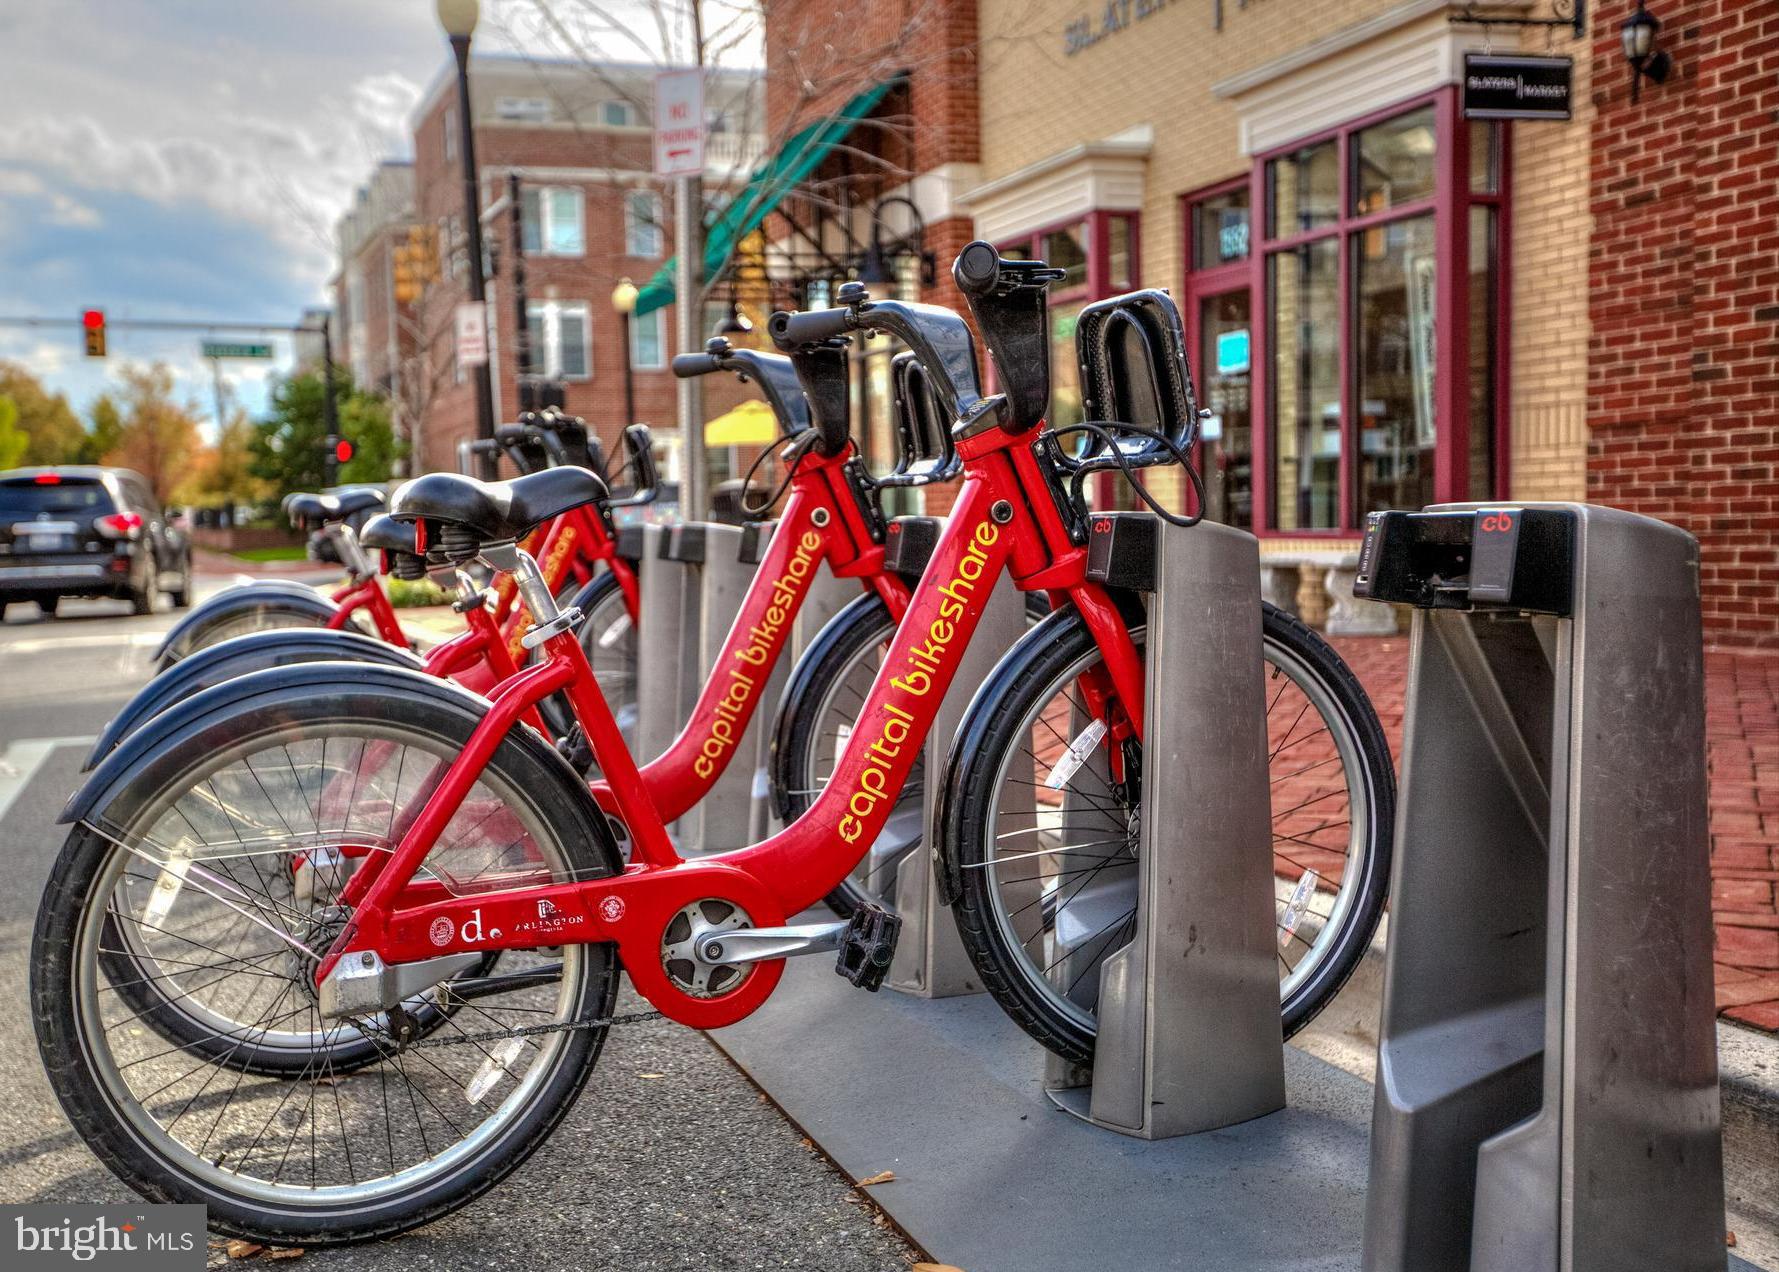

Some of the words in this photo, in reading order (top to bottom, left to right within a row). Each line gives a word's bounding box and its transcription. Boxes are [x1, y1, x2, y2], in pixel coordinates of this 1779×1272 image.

[1467, 75, 1517, 90] SLATERS
[1522, 84, 1568, 98] MARKET
[694, 669, 754, 779] capital
[735, 531, 821, 667] bikeshare
[838, 702, 914, 845] capital
[889, 521, 999, 696] bikeshare
